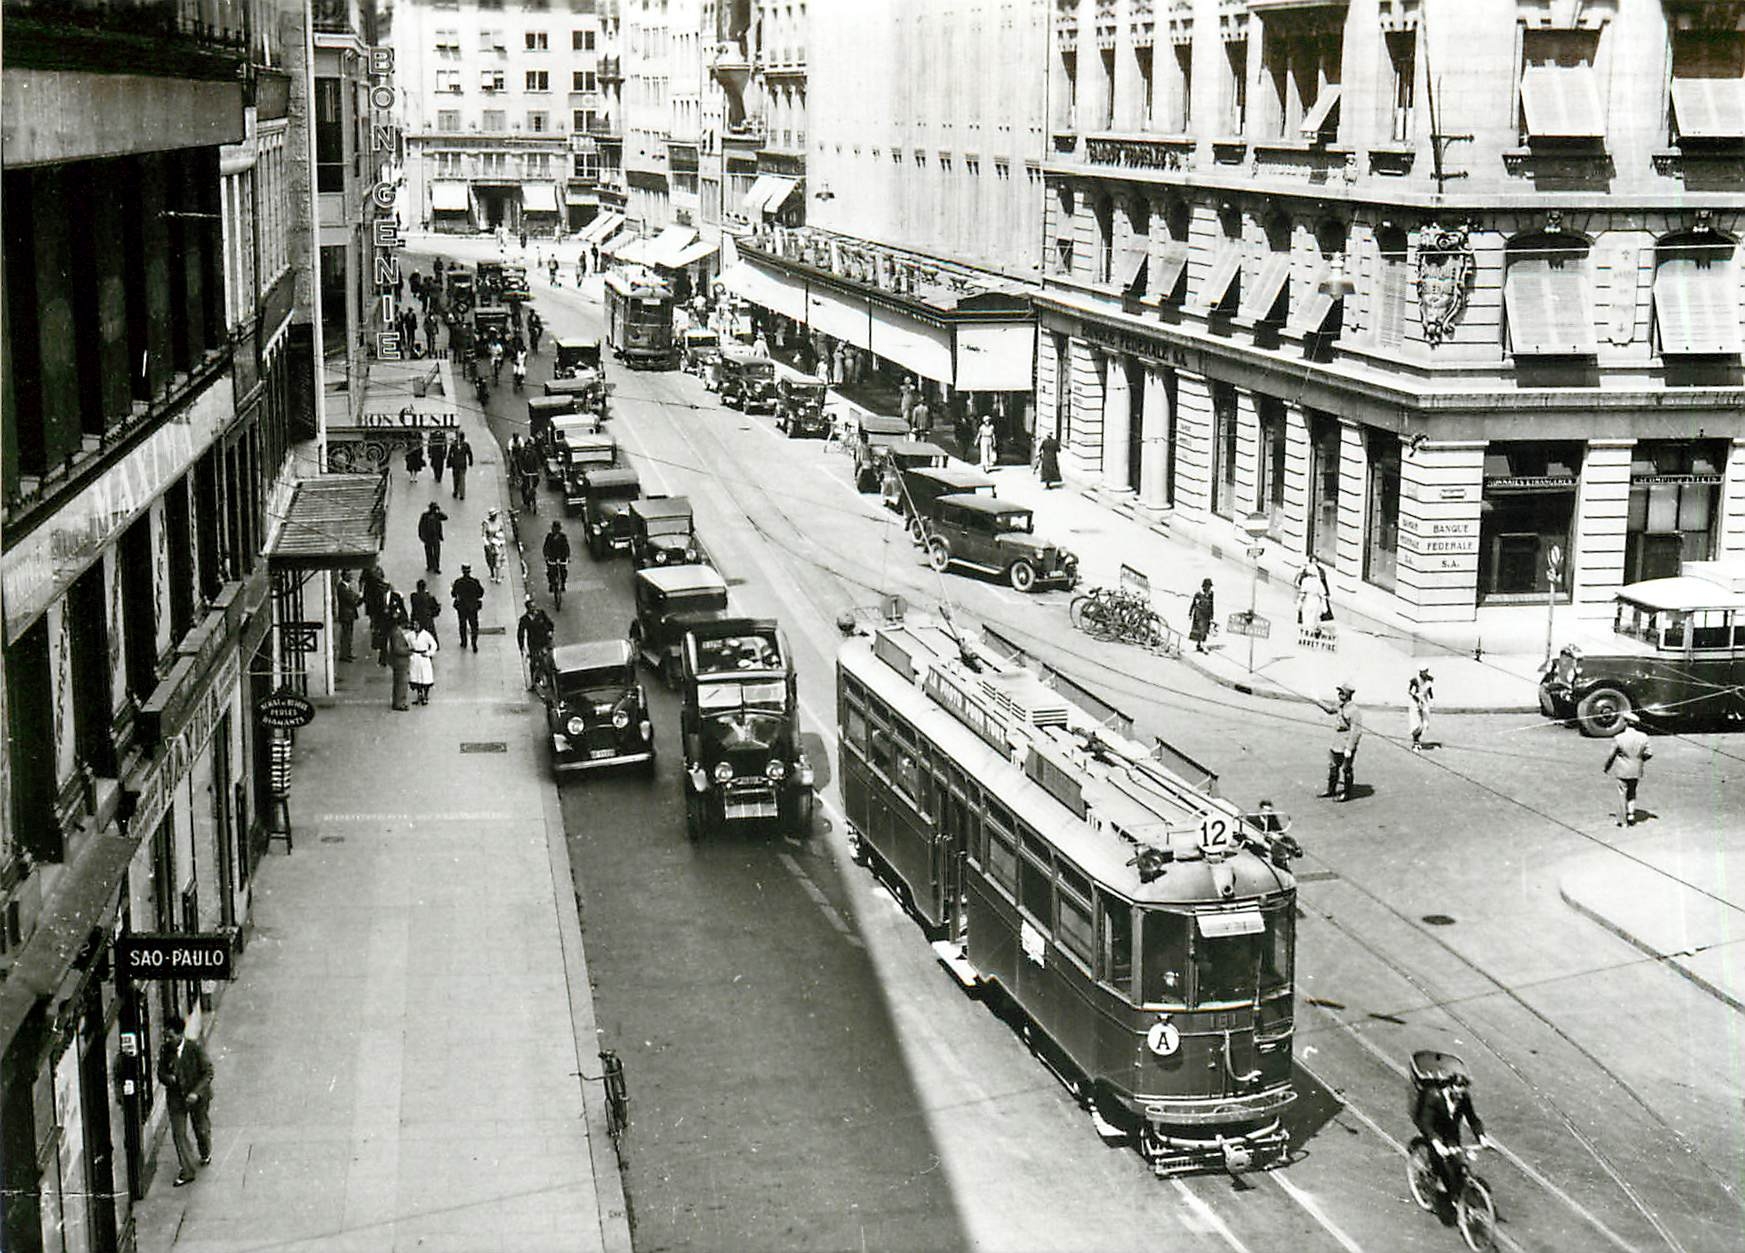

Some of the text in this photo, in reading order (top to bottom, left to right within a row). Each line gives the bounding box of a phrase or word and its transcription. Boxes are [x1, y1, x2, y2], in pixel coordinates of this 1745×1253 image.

[368, 46, 401, 360] BON GENIE
[1432, 524, 1469, 534] BANQUE
[1426, 541, 1473, 551] FEDERALE
[1299, 628, 1336, 641] TRAWAY
[1200, 819, 1228, 848] 12
[130, 949, 225, 967] SAO-PAULO
[1156, 1031, 1171, 1050] A
